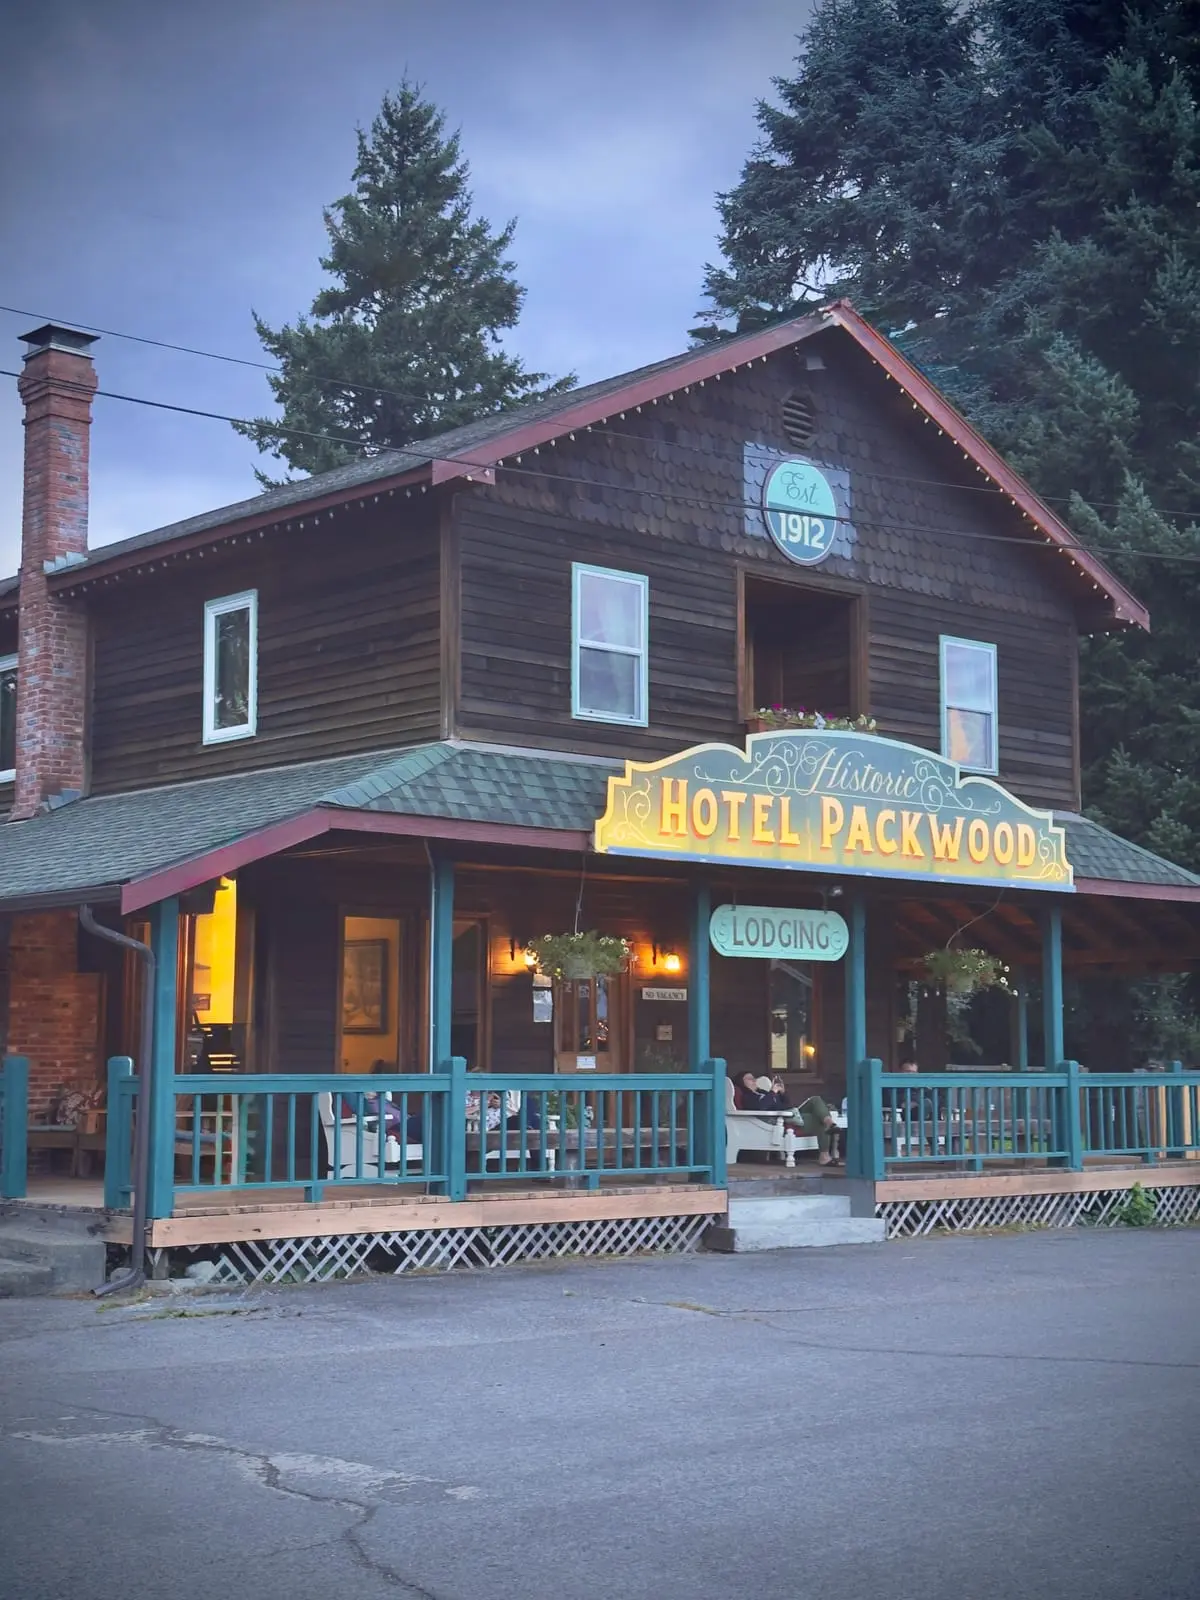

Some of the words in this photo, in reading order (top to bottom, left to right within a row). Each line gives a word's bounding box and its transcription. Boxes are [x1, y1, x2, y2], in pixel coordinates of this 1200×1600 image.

[778, 511, 825, 550] 1912
[797, 745, 919, 798] Historic
[659, 776, 801, 847] HOTEL
[819, 795, 1036, 868] PACKWOOD
[732, 915, 829, 950] LODGING
